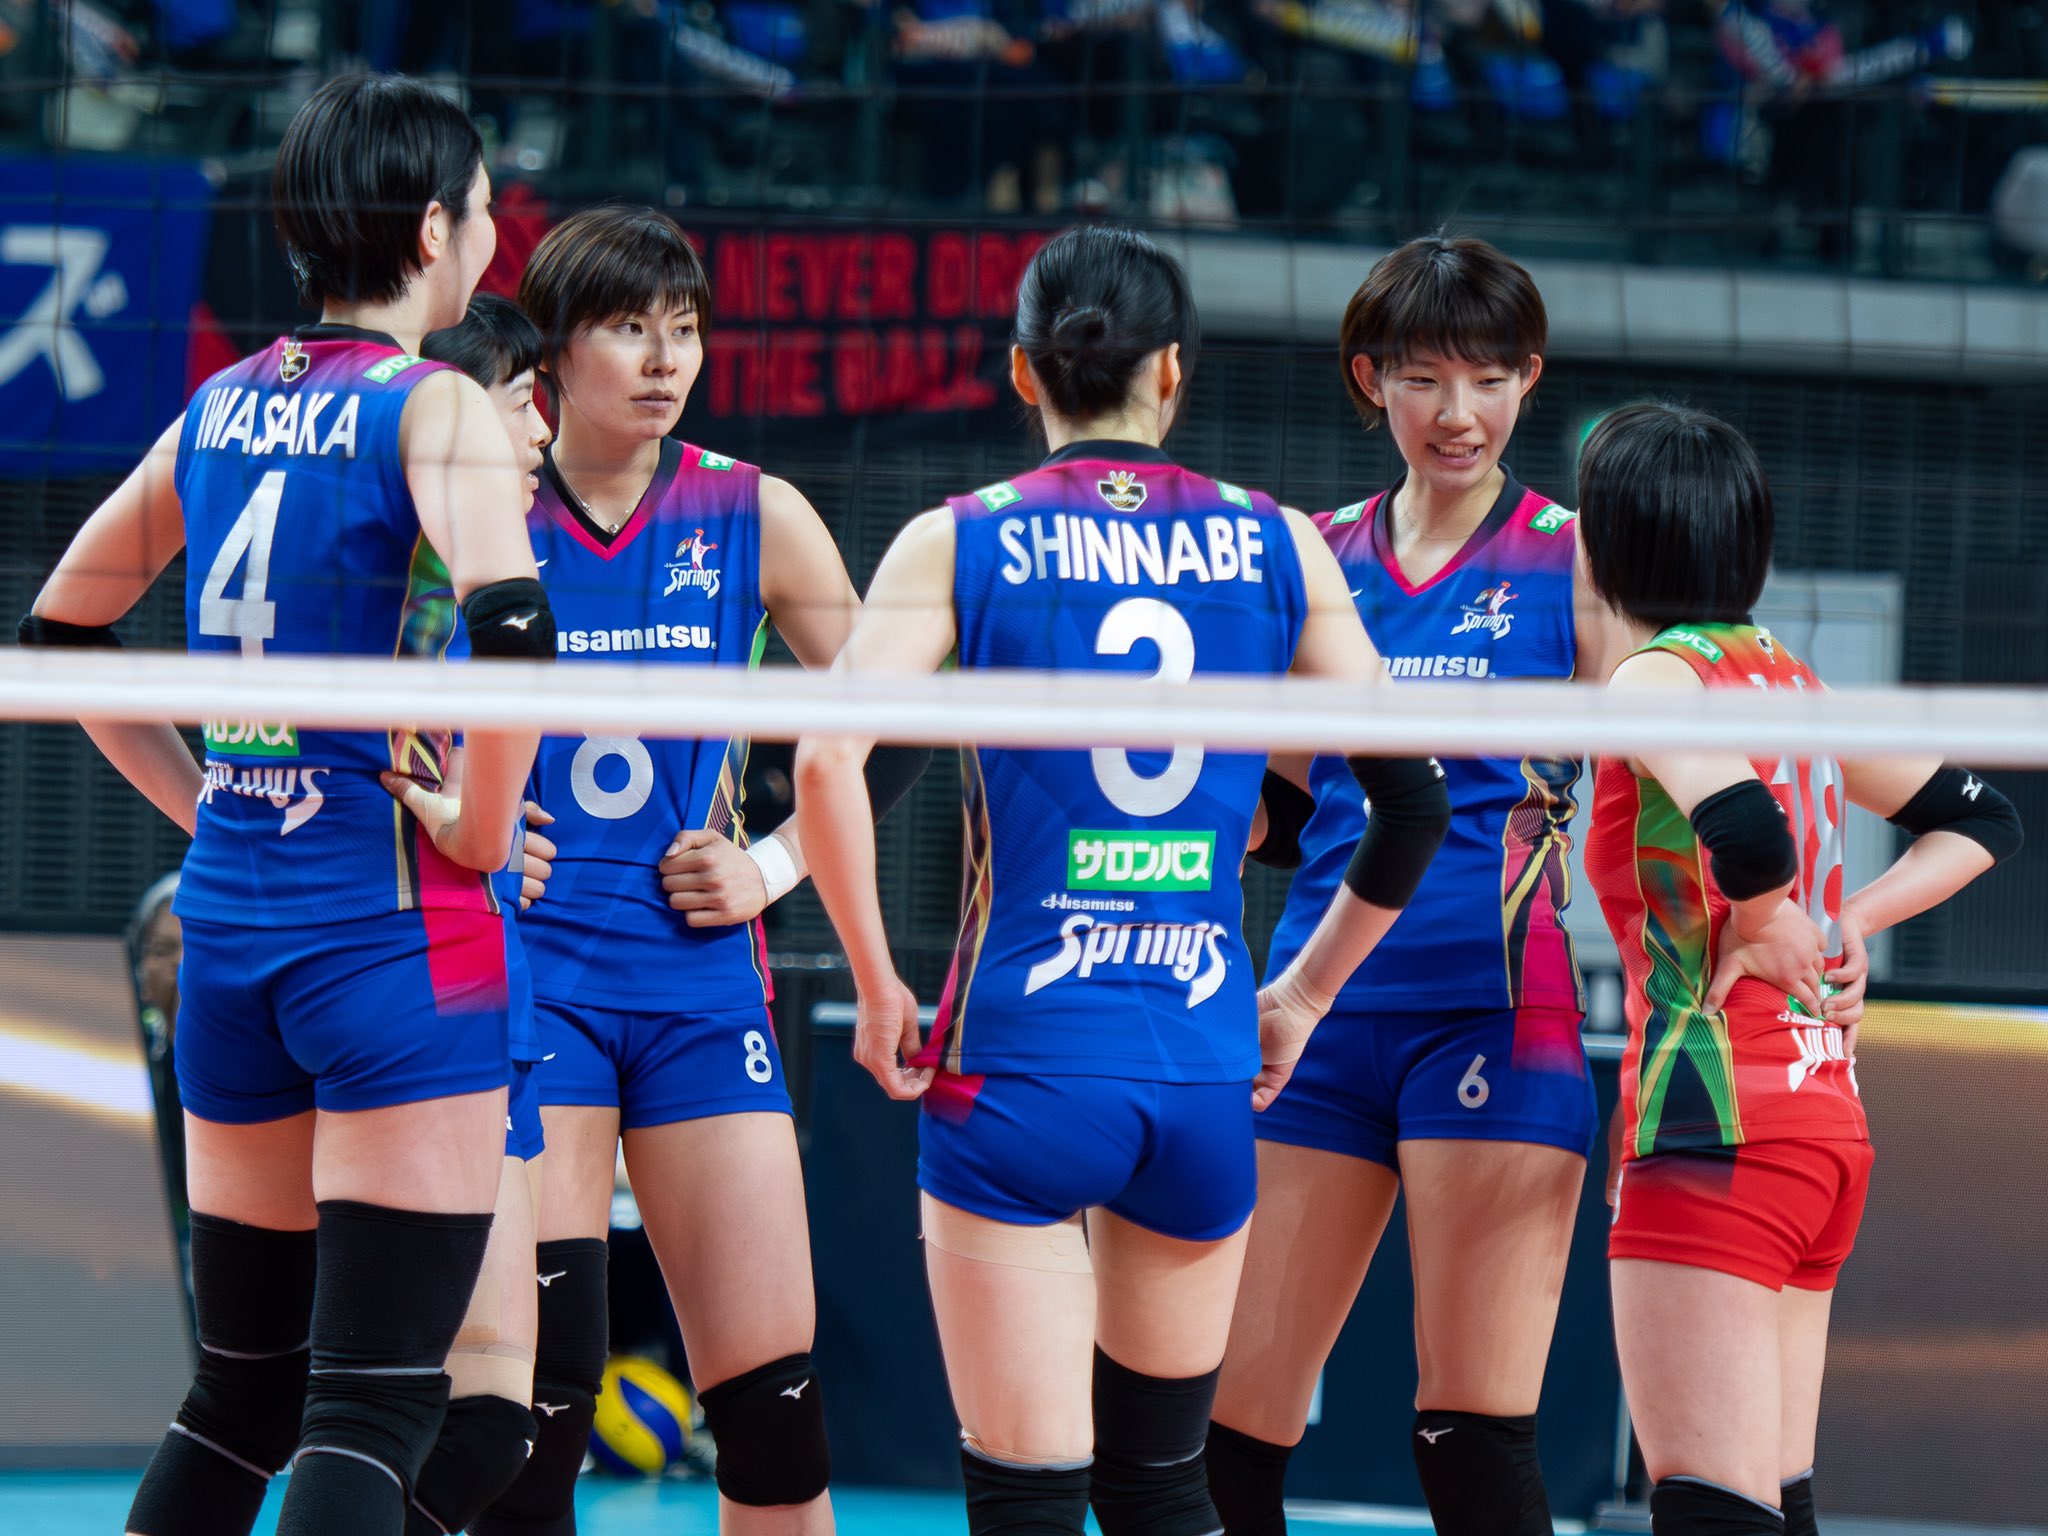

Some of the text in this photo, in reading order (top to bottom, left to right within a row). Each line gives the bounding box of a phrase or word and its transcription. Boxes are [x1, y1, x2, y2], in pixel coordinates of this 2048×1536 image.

[713, 230, 917, 322] NEVER
[0, 223, 129, 403] ズ
[706, 327, 826, 418] THE
[195, 386, 361, 459] IWASAKA
[199, 471, 286, 662] 4
[663, 567, 721, 600] Springs
[1000, 513, 1263, 585] SHINNABE
[1450, 611, 1515, 641] Springs
[1090, 597, 1205, 817] 3
[1072, 838, 1210, 883] サロンパス
[1041, 893, 1135, 912] Hisamitsu
[1024, 914, 1228, 1010] Springs
[743, 1030, 772, 1084] 8
[1457, 1053, 1487, 1109] 6
